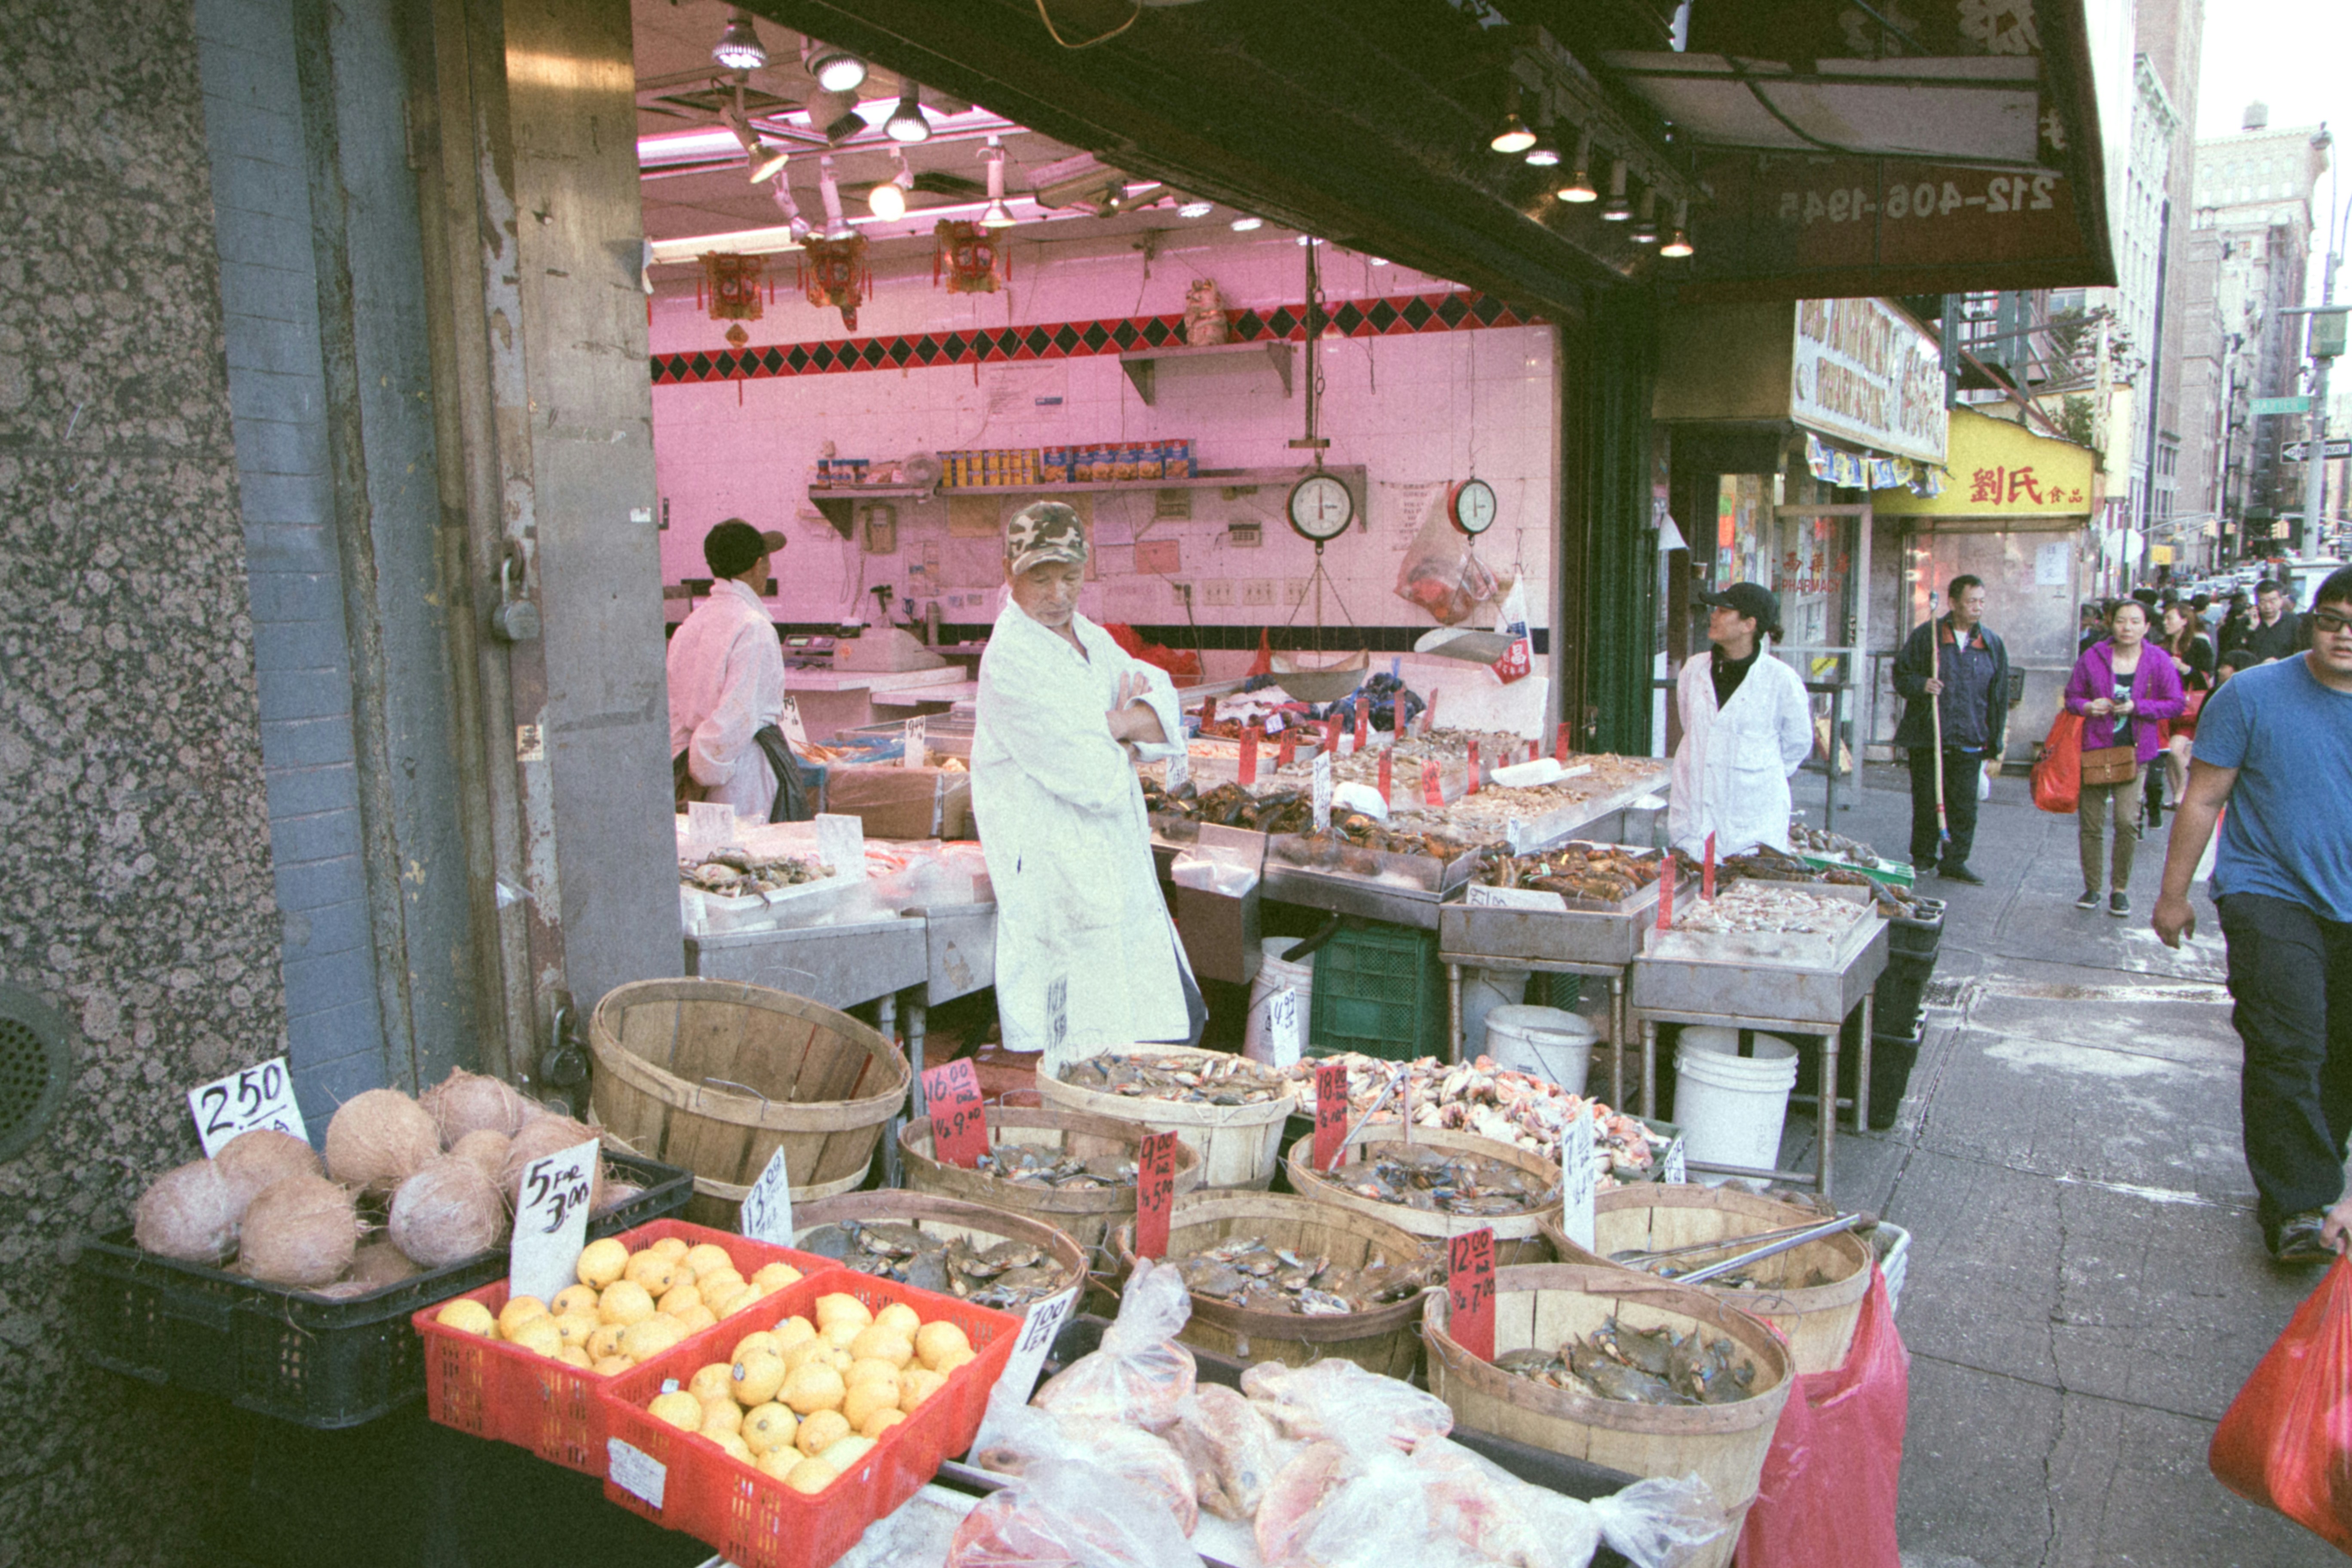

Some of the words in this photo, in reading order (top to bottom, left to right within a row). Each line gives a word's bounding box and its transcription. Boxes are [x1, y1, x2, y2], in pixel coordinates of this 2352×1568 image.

[2289, 448, 2309, 457] ONE
[1969, 466, 2043, 505] 劉氏
[2047, 485, 2083, 504] 食品
[1782, 579, 1842, 592] PHARMACY
[201, 1064, 281, 1136] 2.50
[928, 1064, 968, 1102] 16.00
[953, 1107, 981, 1136] 9.00
[526, 1159, 554, 1209] 5
[553, 1165, 585, 1190] FOR
[542, 1181, 590, 1234] 3.00
[1450, 1231, 1489, 1274] 12.00
